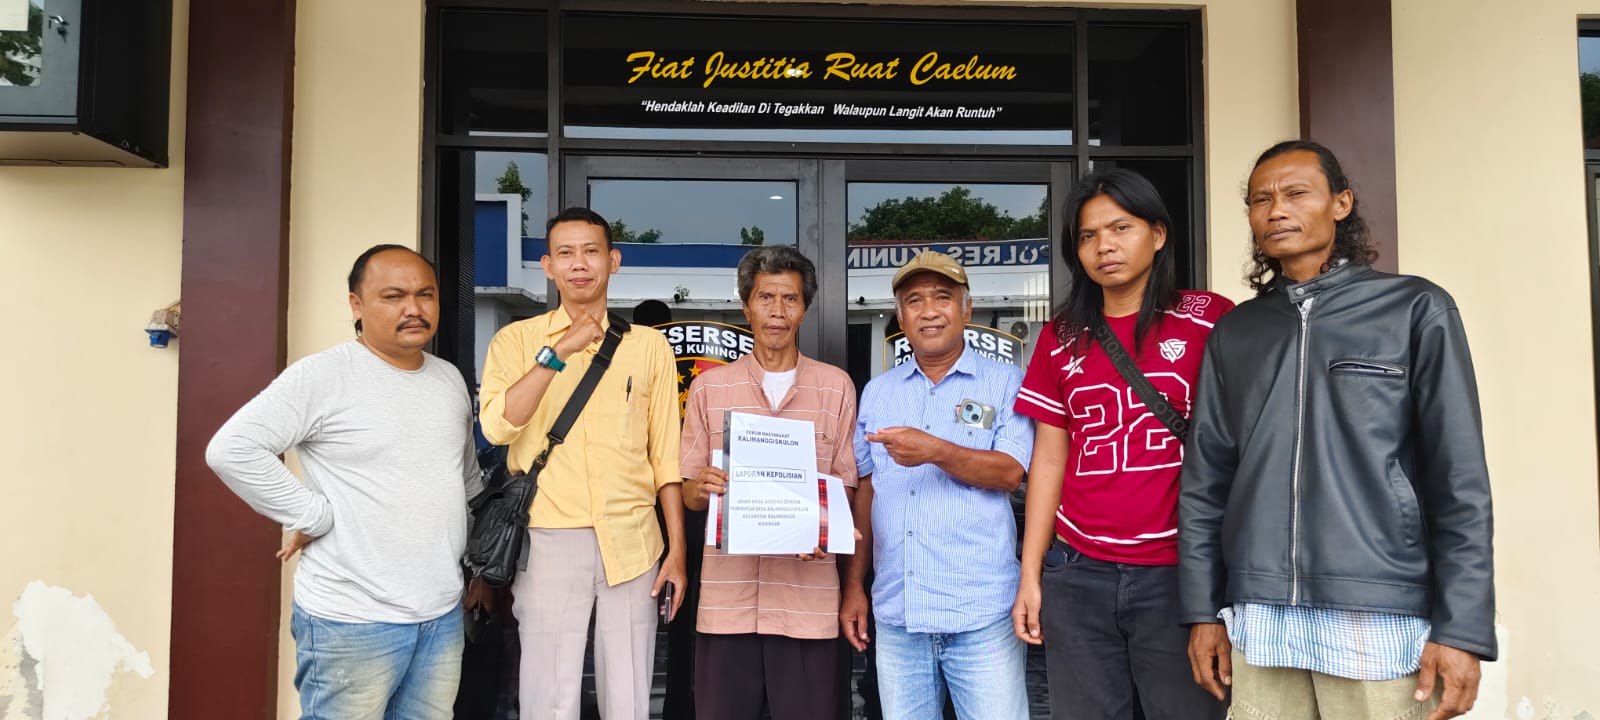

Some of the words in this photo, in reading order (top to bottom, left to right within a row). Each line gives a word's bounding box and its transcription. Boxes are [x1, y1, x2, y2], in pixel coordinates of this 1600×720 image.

[626, 51, 695, 84] Fiat
[703, 51, 813, 89] Justitia
[823, 52, 900, 81] Ruat
[909, 51, 1017, 85] Caelum
[707, 101, 755, 114] Keadilan
[757, 103, 770, 114] Di
[773, 103, 825, 117] Tegakkan
[833, 104, 887, 118] Walaupun
[889, 106, 925, 120] Langit
[925, 107, 955, 118] Akan
[1176, 294, 1211, 317] 22
[1068, 373, 1190, 476] 22
[736, 470, 765, 478] LAPORAN
[766, 471, 803, 480] KEPOLISIAN
